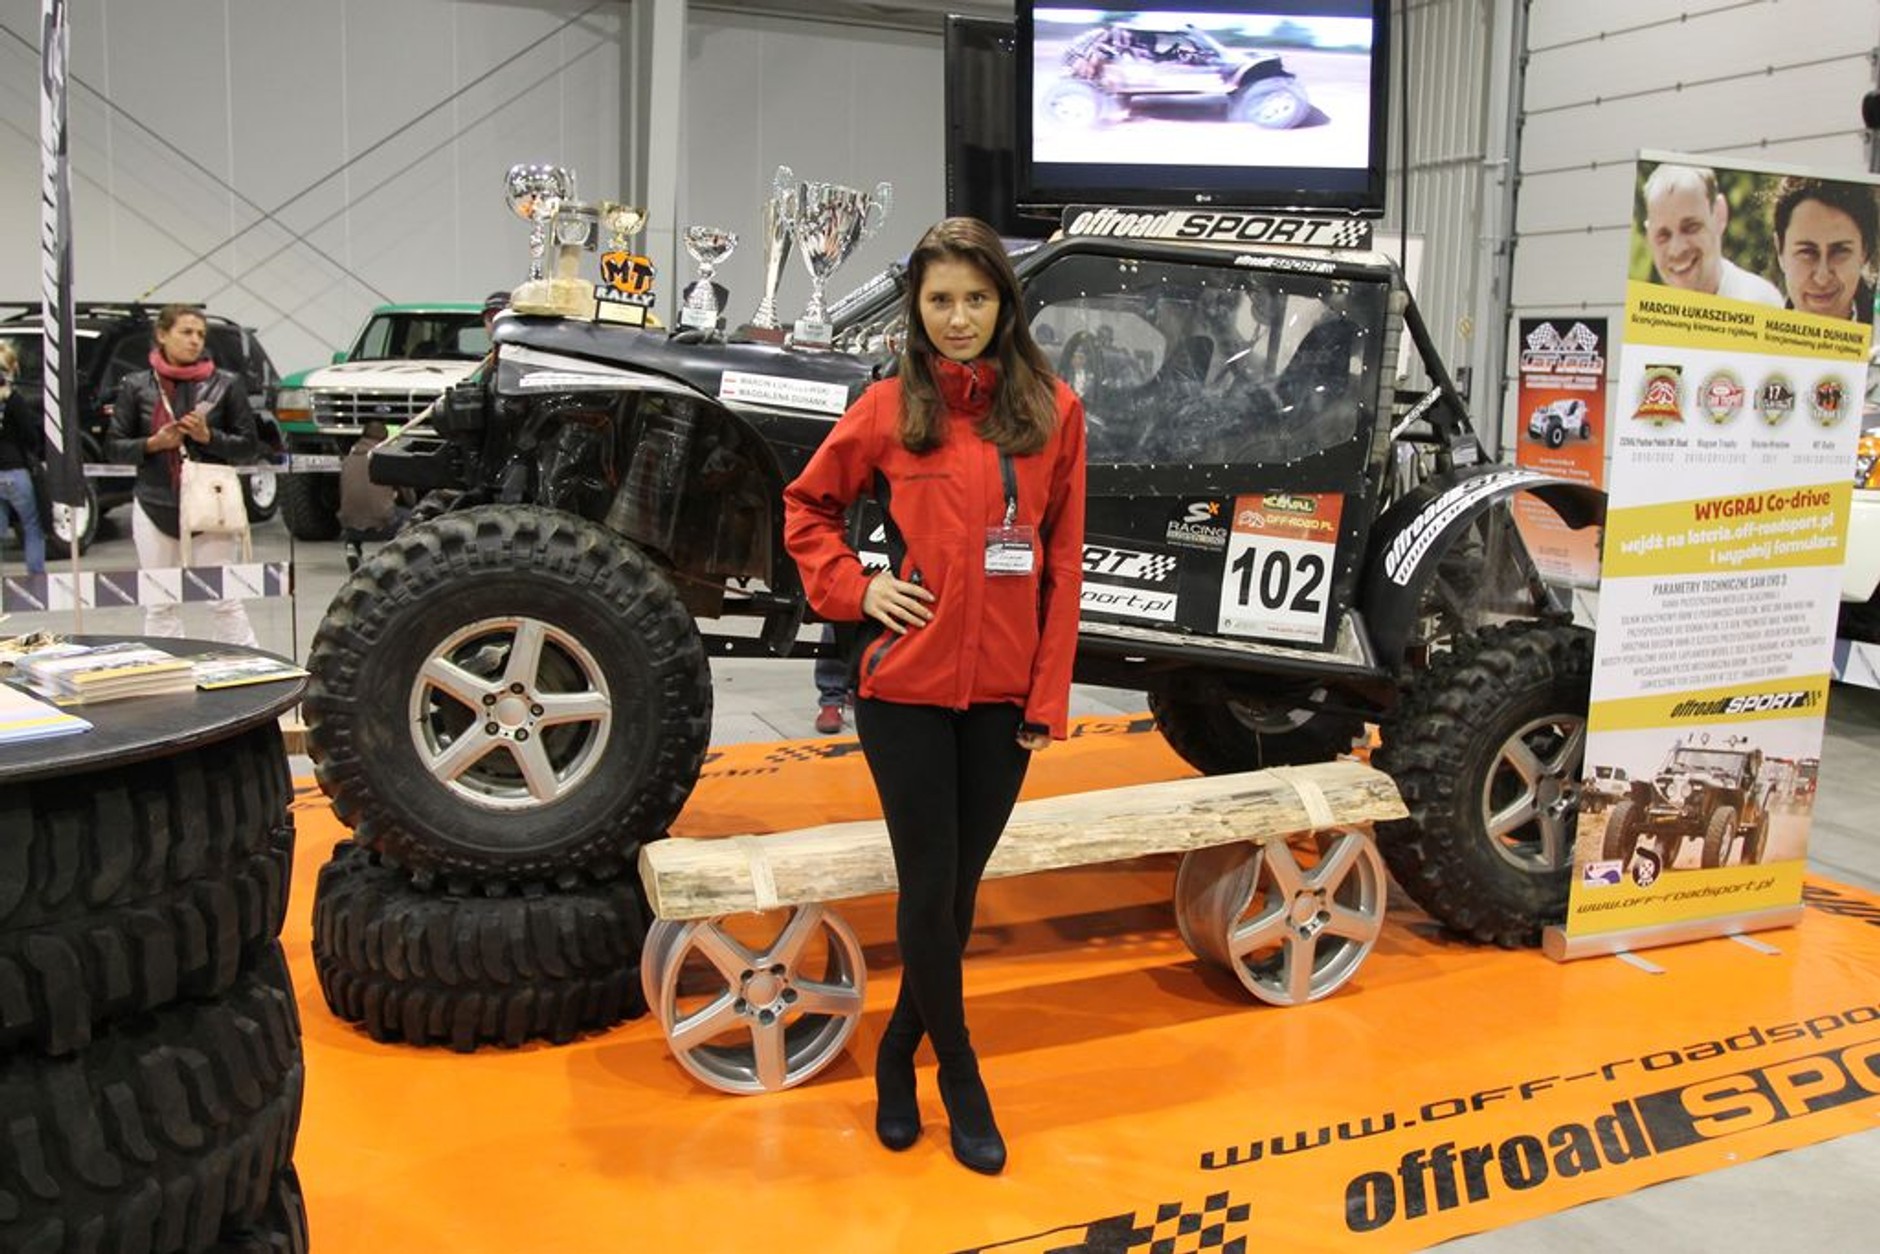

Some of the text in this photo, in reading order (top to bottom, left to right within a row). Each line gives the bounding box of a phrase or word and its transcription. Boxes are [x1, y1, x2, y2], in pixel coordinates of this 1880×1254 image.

[1176, 214, 1331, 243] SPORT
[605, 259, 653, 289] MT
[595, 285, 654, 306] RALLY
[1639, 300, 1755, 325] MARCIN ŁUKASZEWSKI
[1765, 319, 1821, 338] MAGDALENA
[1694, 490, 1831, 521] WYGRAJ Co-drive
[1166, 520, 1228, 539] RACING
[1231, 546, 1325, 614] 102
[1725, 691, 1805, 714] SPORT
[1344, 1100, 1651, 1233] offroad
